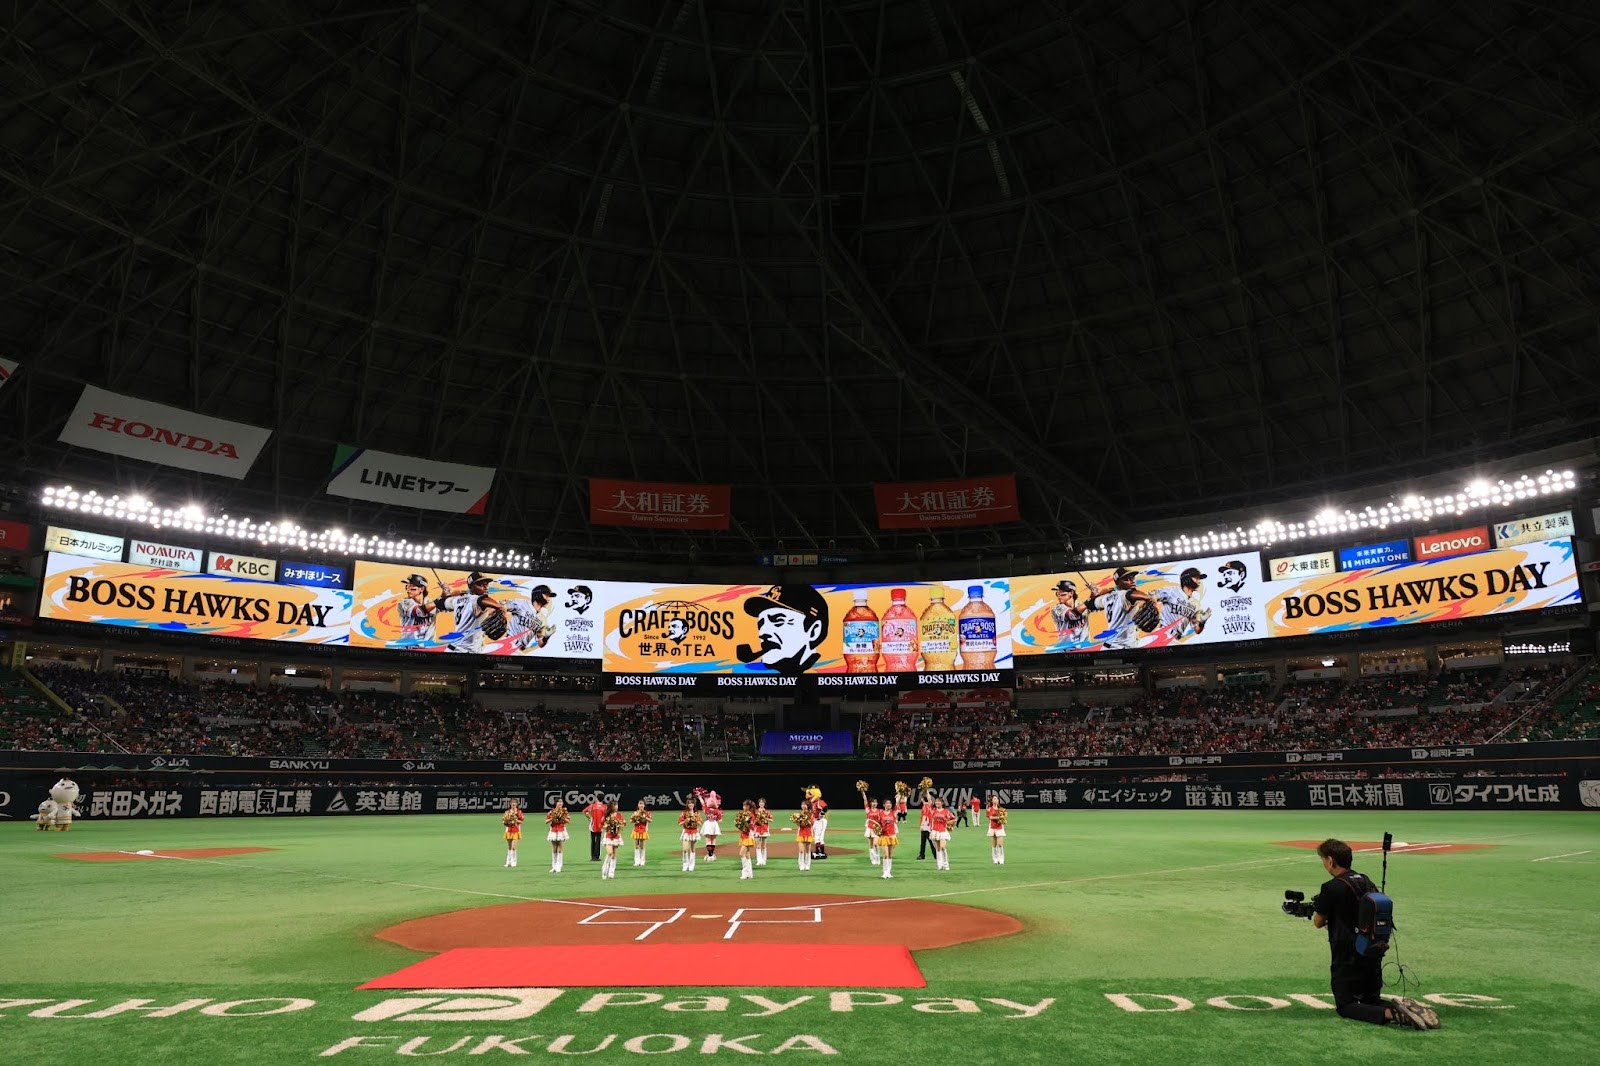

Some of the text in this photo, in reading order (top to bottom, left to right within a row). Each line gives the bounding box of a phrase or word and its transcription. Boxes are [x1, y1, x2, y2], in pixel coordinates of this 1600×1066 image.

[88, 412, 240, 460] HONDA
[361, 469, 469, 495] LINEヤフー
[612, 489, 711, 514] 大和証券
[896, 486, 996, 512] 大和証券
[1521, 516, 1570, 533] 共立製薬
[59, 536, 122, 554] 日本カルミック
[136, 543, 196, 561] NOMURA
[1421, 536, 1482, 555] Lenovo
[1289, 558, 1331, 572] 大東建託
[1354, 552, 1408, 567] MIRAIT ONE
[237, 561, 270, 576] KBC
[284, 568, 342, 584] みずほリース
[1284, 562, 1551, 620] BOSS HAWKS DAY
[67, 576, 334, 628] BOSS HAWKS DAY
[686, 611, 735, 640] BOSS
[1224, 614, 1251, 623] SoftBank
[1431, 620, 1465, 630] XPERIA
[1222, 622, 1256, 635] HAWKS
[210, 636, 242, 645] XPERIA
[307, 644, 337, 653] XPERIA
[564, 641, 594, 653] HAWKS
[616, 676, 697, 686] BOSS HAWKS DAY
[717, 677, 798, 687] BOSS HAWKS DAY
[818, 675, 898, 685] BOSS HAWKS DAY
[918, 673, 1001, 684] BOSS HAWKS DAY
[789, 734, 824, 742] MIZUHO
[168, 757, 191, 767] 山九
[269, 760, 330, 770] SANKYU
[416, 760, 436, 771] 山九
[503, 762, 557, 772] SANKYU
[633, 762, 651, 772] 山九
[199, 789, 312, 815] 西部電気工業
[355, 791, 422, 812] 英進館
[1011, 788, 1067, 804] 第一商事
[1097, 788, 1173, 804] エイジェック
[1185, 791, 1287, 807] 昭和建設
[1308, 783, 1405, 807] 西日本新聞
[1454, 784, 1561, 804] ダイワ化成
[90, 790, 183, 817] 武田メガネ
[576, 990, 1056, 1018] PayPay
[319, 1033, 840, 1057] FUKUOKA
